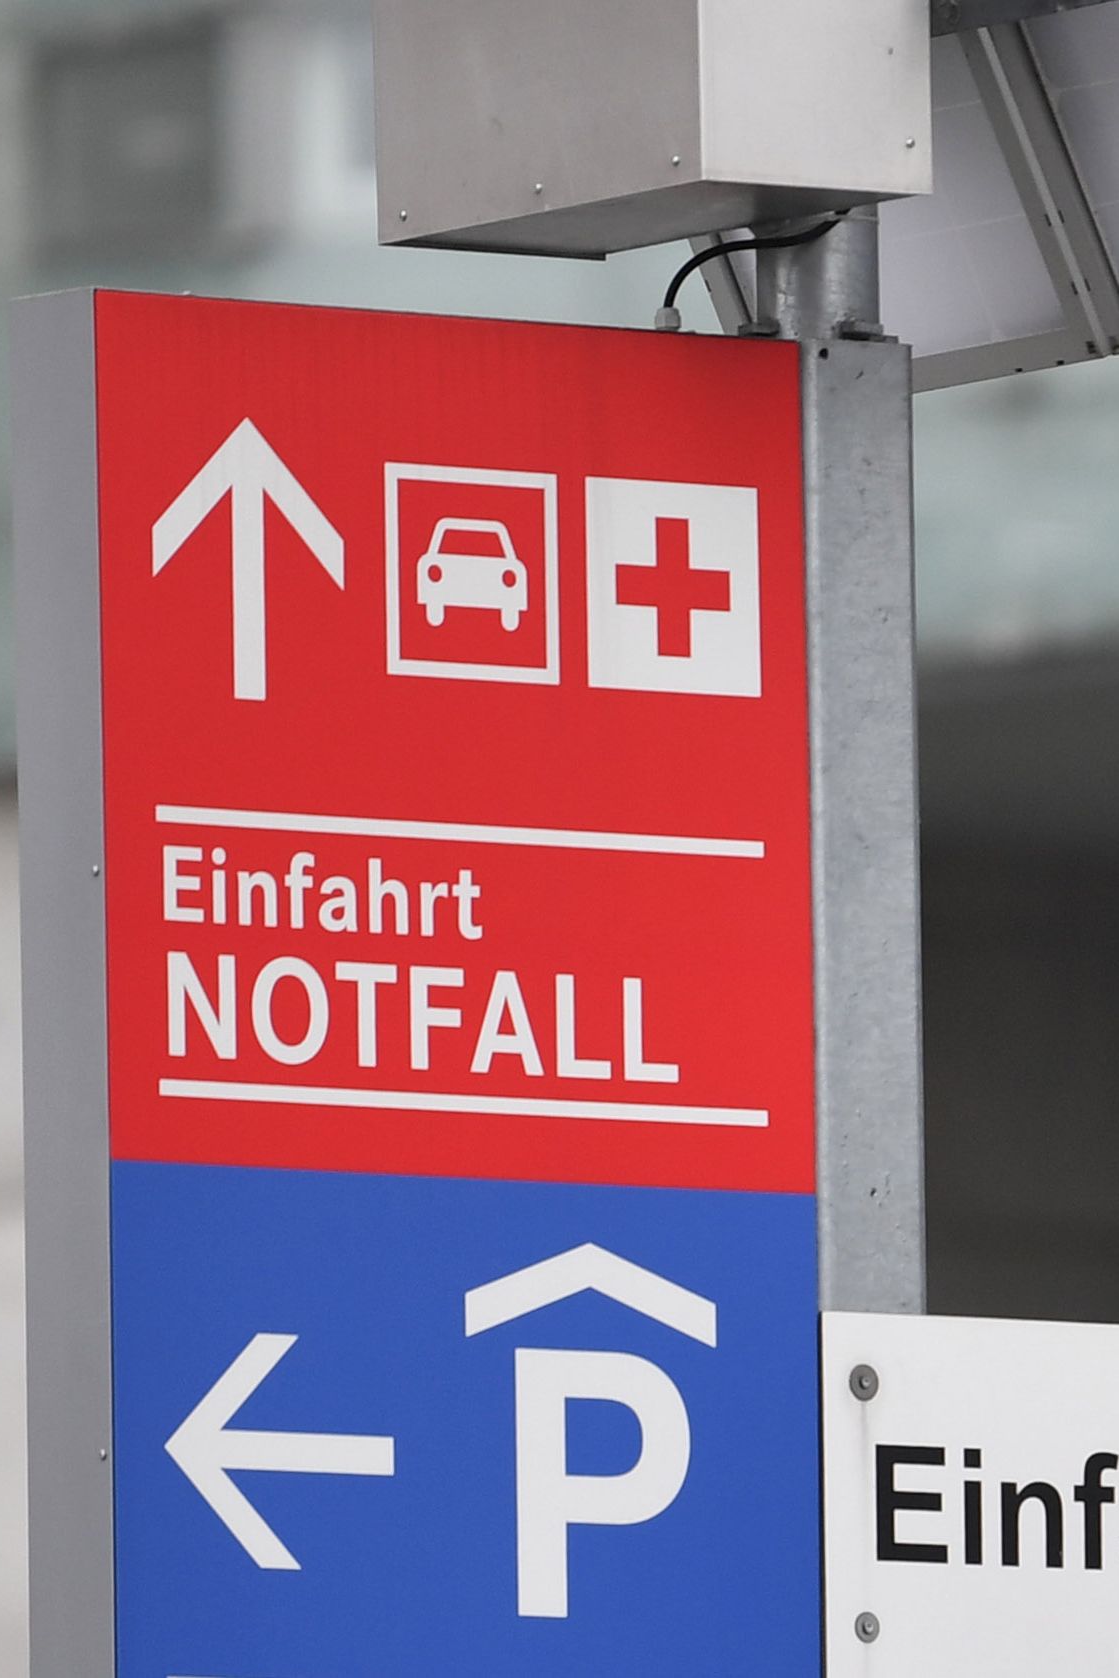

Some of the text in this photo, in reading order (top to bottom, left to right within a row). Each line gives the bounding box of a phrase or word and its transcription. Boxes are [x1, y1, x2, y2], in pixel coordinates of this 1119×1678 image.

[161, 844, 483, 940] Einfahrt
[166, 951, 680, 1084] NOTFALL
[514, 1348, 691, 1618] P
[875, 1444, 1119, 1570] Einf
